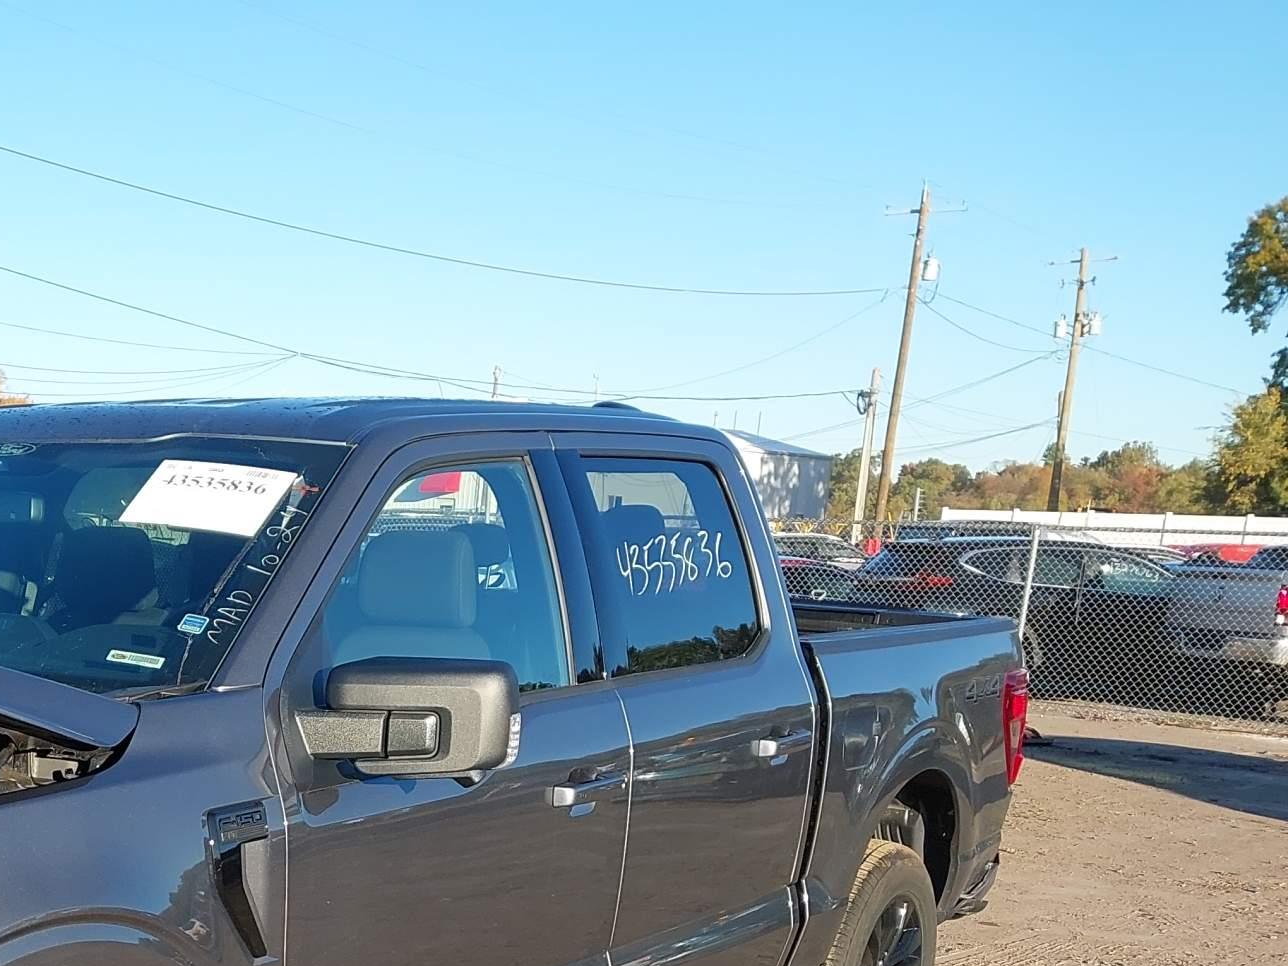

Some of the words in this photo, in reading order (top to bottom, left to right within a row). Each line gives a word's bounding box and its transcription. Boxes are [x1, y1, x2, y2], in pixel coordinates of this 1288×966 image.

[162, 474, 267, 495] 43535836
[616, 530, 732, 596] 43535836
[207, 590, 253, 645] MAD
